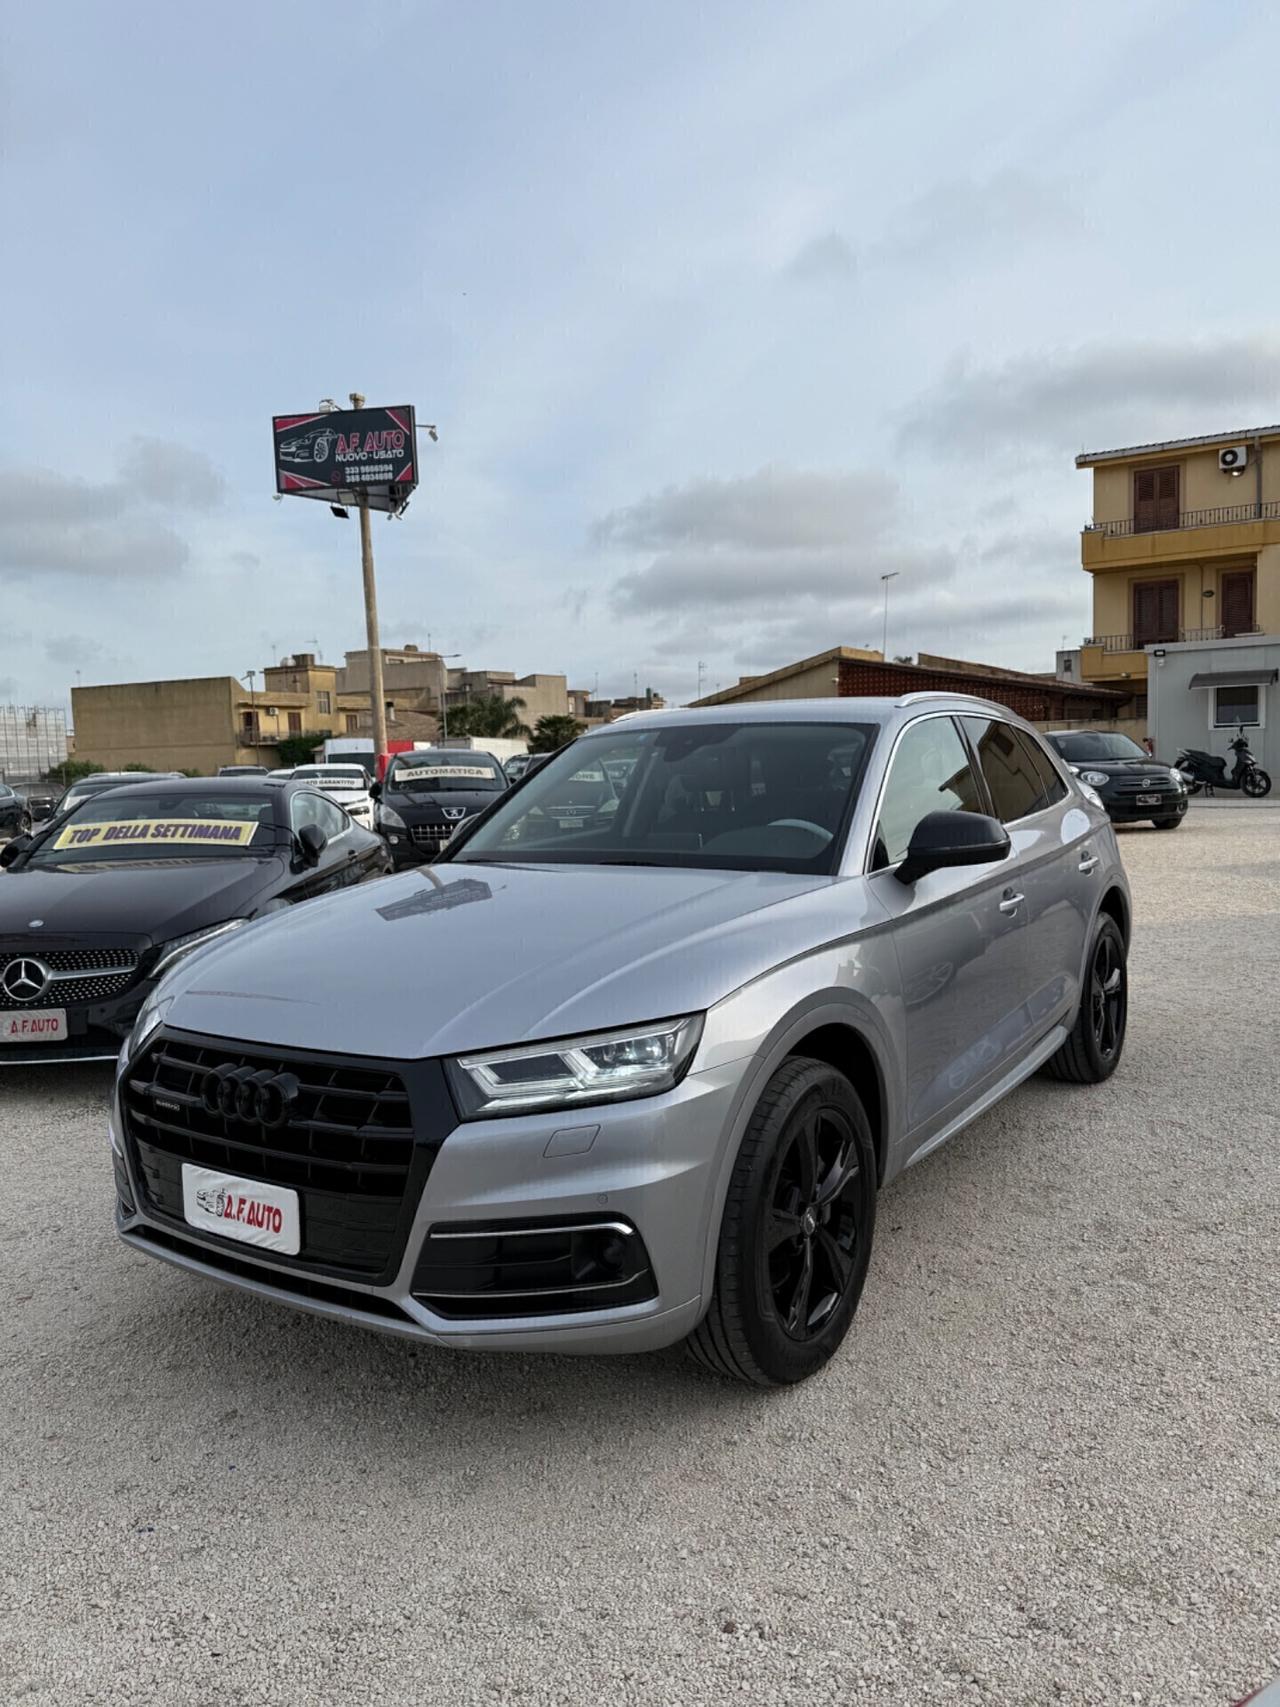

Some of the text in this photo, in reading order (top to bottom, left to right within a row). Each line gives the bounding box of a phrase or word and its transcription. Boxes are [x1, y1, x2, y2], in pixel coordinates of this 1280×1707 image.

[363, 430, 405, 452] AUTO
[335, 450, 404, 462] NUOVO USATO
[407, 768, 484, 777] AUTOMATICA
[68, 824, 243, 844] TOP DELLA SETTIMANA
